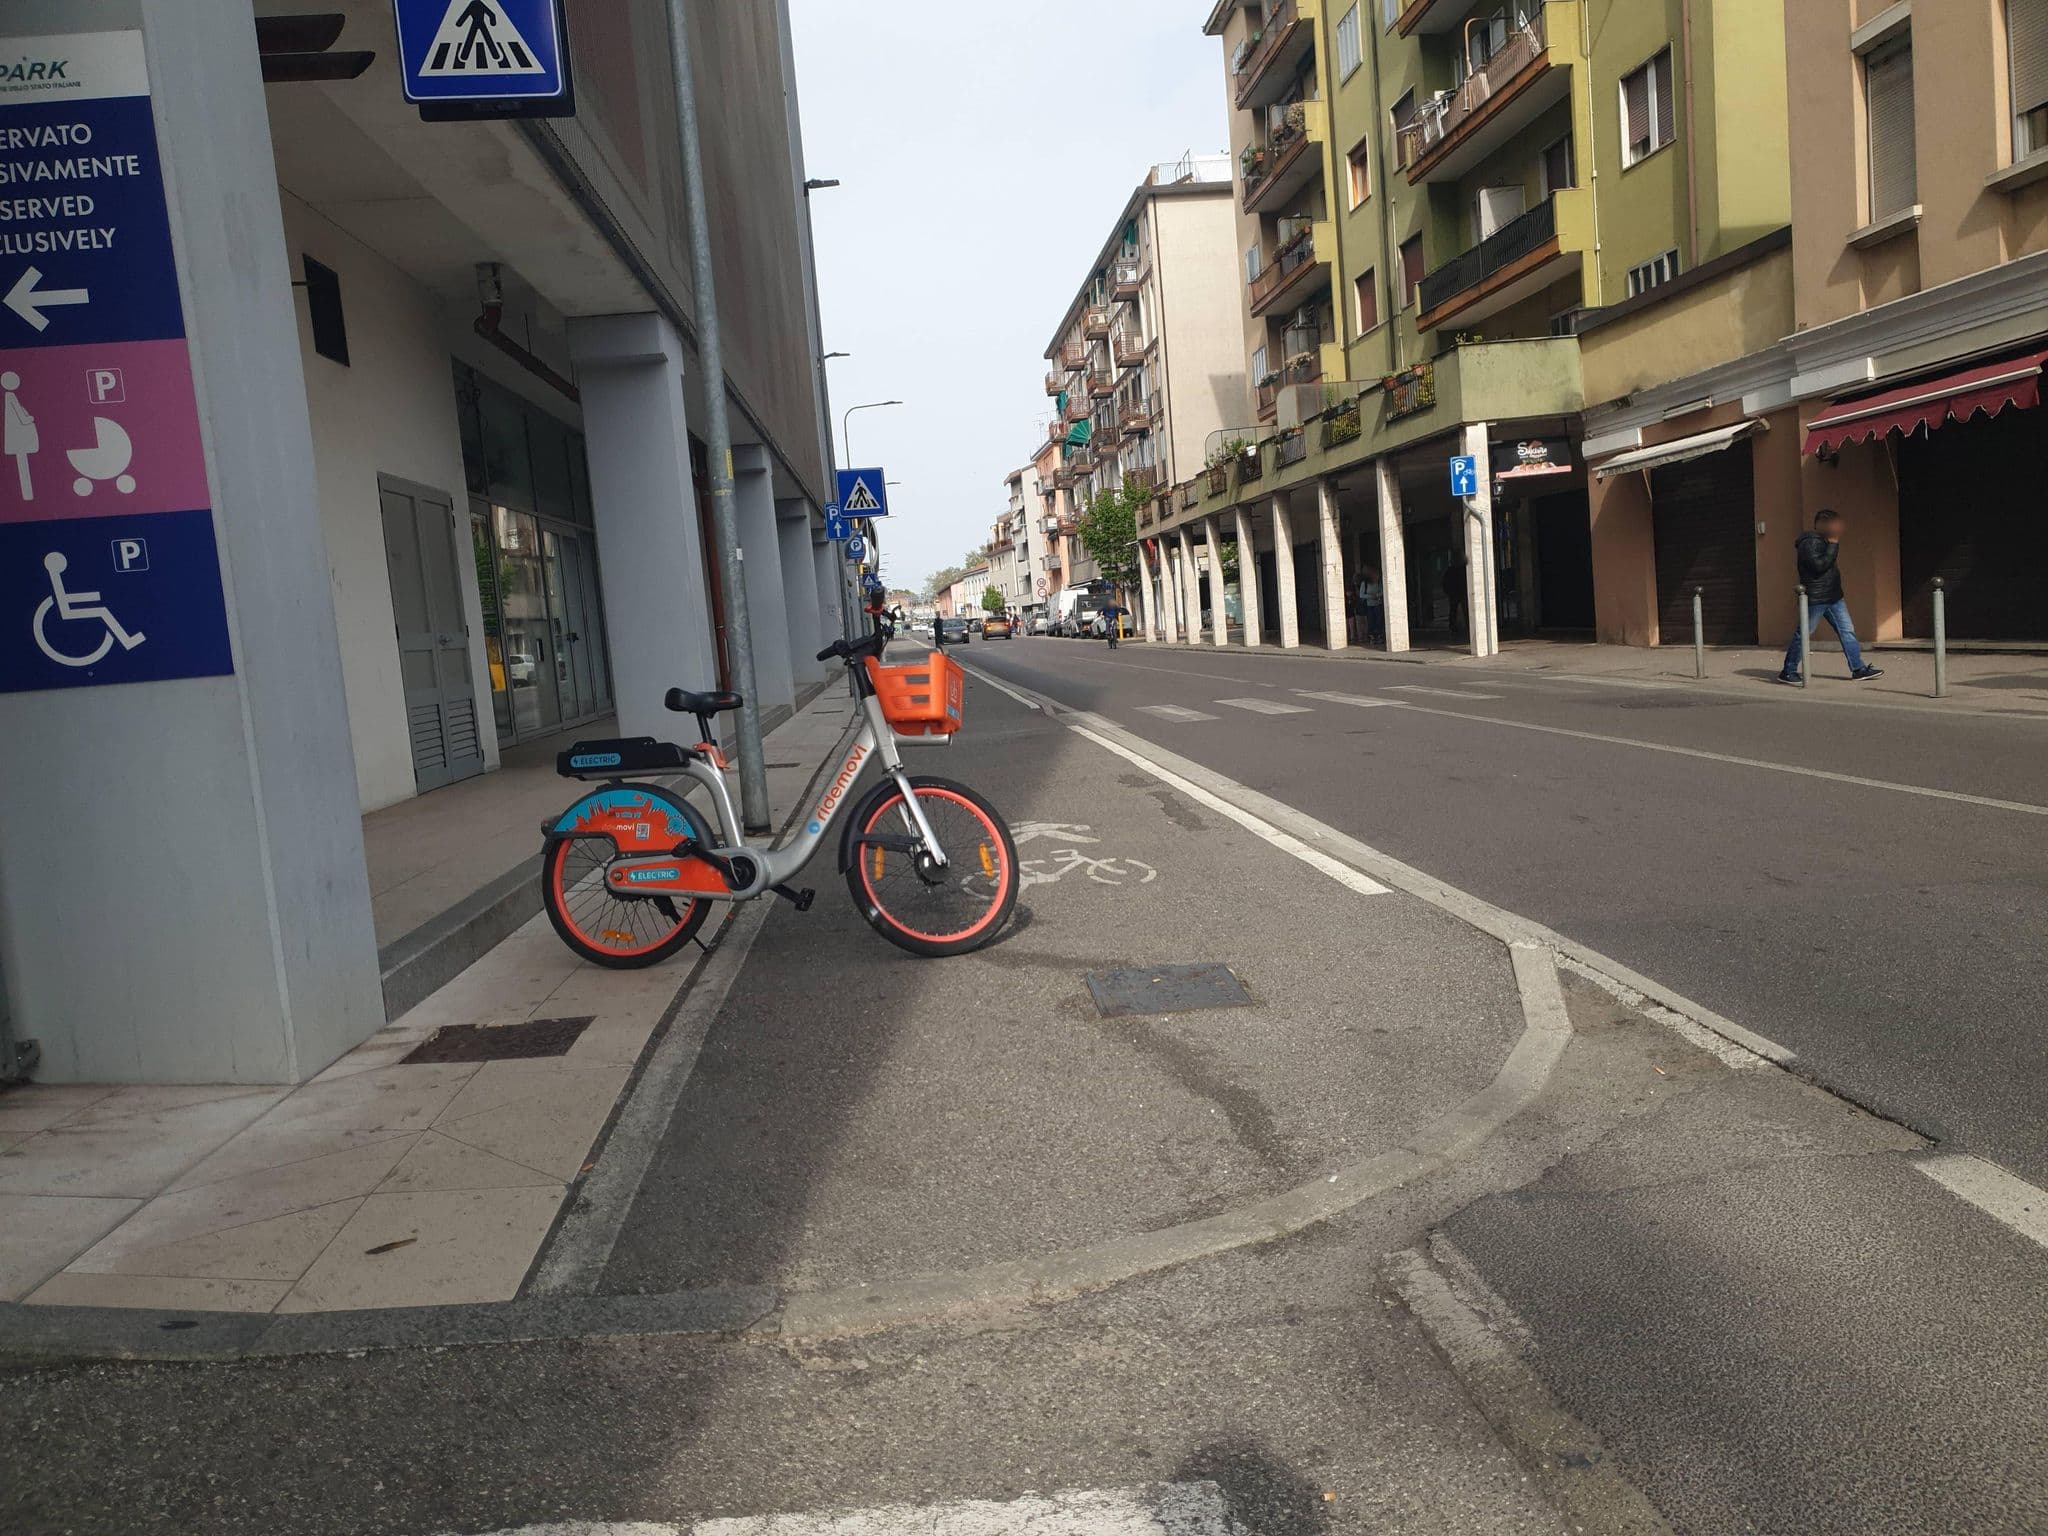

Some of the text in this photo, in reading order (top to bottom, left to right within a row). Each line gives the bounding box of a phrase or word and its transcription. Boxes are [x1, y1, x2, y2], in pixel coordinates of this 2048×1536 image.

[0, 195, 95, 221] SERVED
[0, 228, 116, 255] LUSIVELY
[95, 371, 116, 401] P
[1455, 462, 1466, 475] P
[829, 508, 838, 520] P
[120, 541, 141, 569] P
[580, 754, 616, 766] ELECTRIC
[816, 743, 868, 822] ridemovi
[637, 870, 675, 880] ELECTRIC
